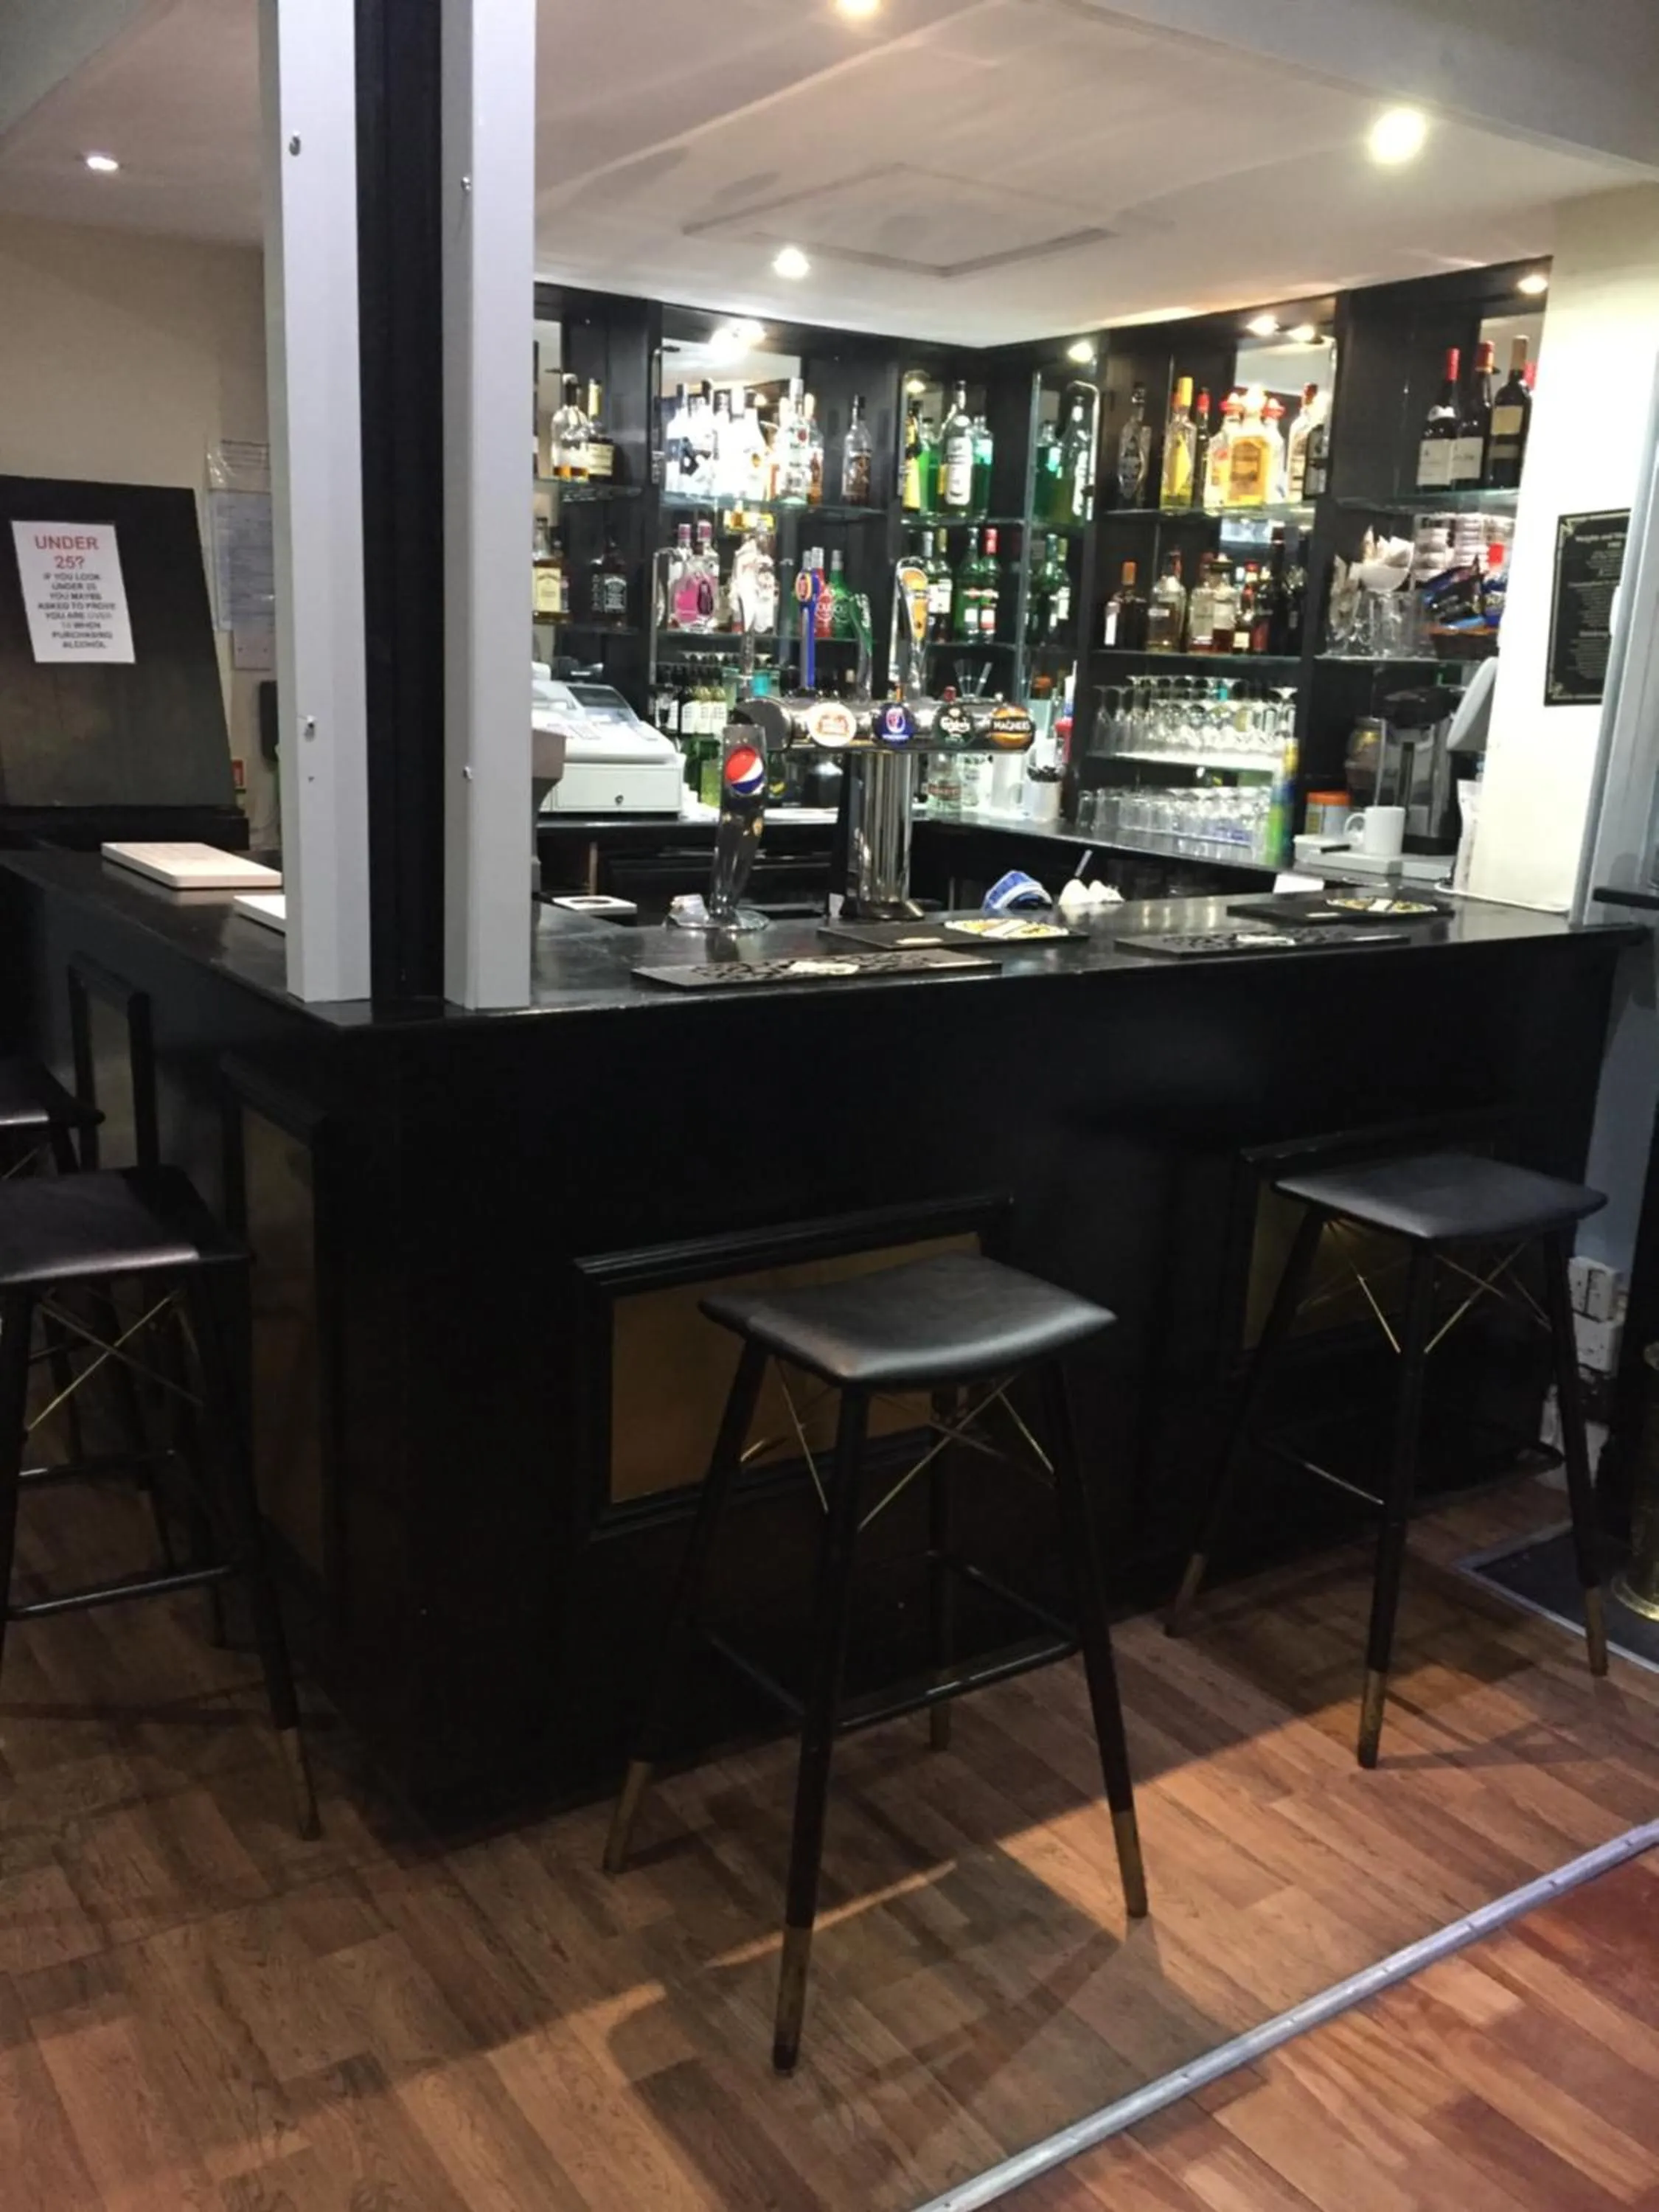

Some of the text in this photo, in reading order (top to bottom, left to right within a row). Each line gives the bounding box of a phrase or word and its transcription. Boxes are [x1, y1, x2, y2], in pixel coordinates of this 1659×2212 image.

[35, 535, 99, 550] UNDER
[55, 555, 85, 569] 25?
[86, 602, 116, 611] PROVE
[52, 631, 113, 639] PURCHASING
